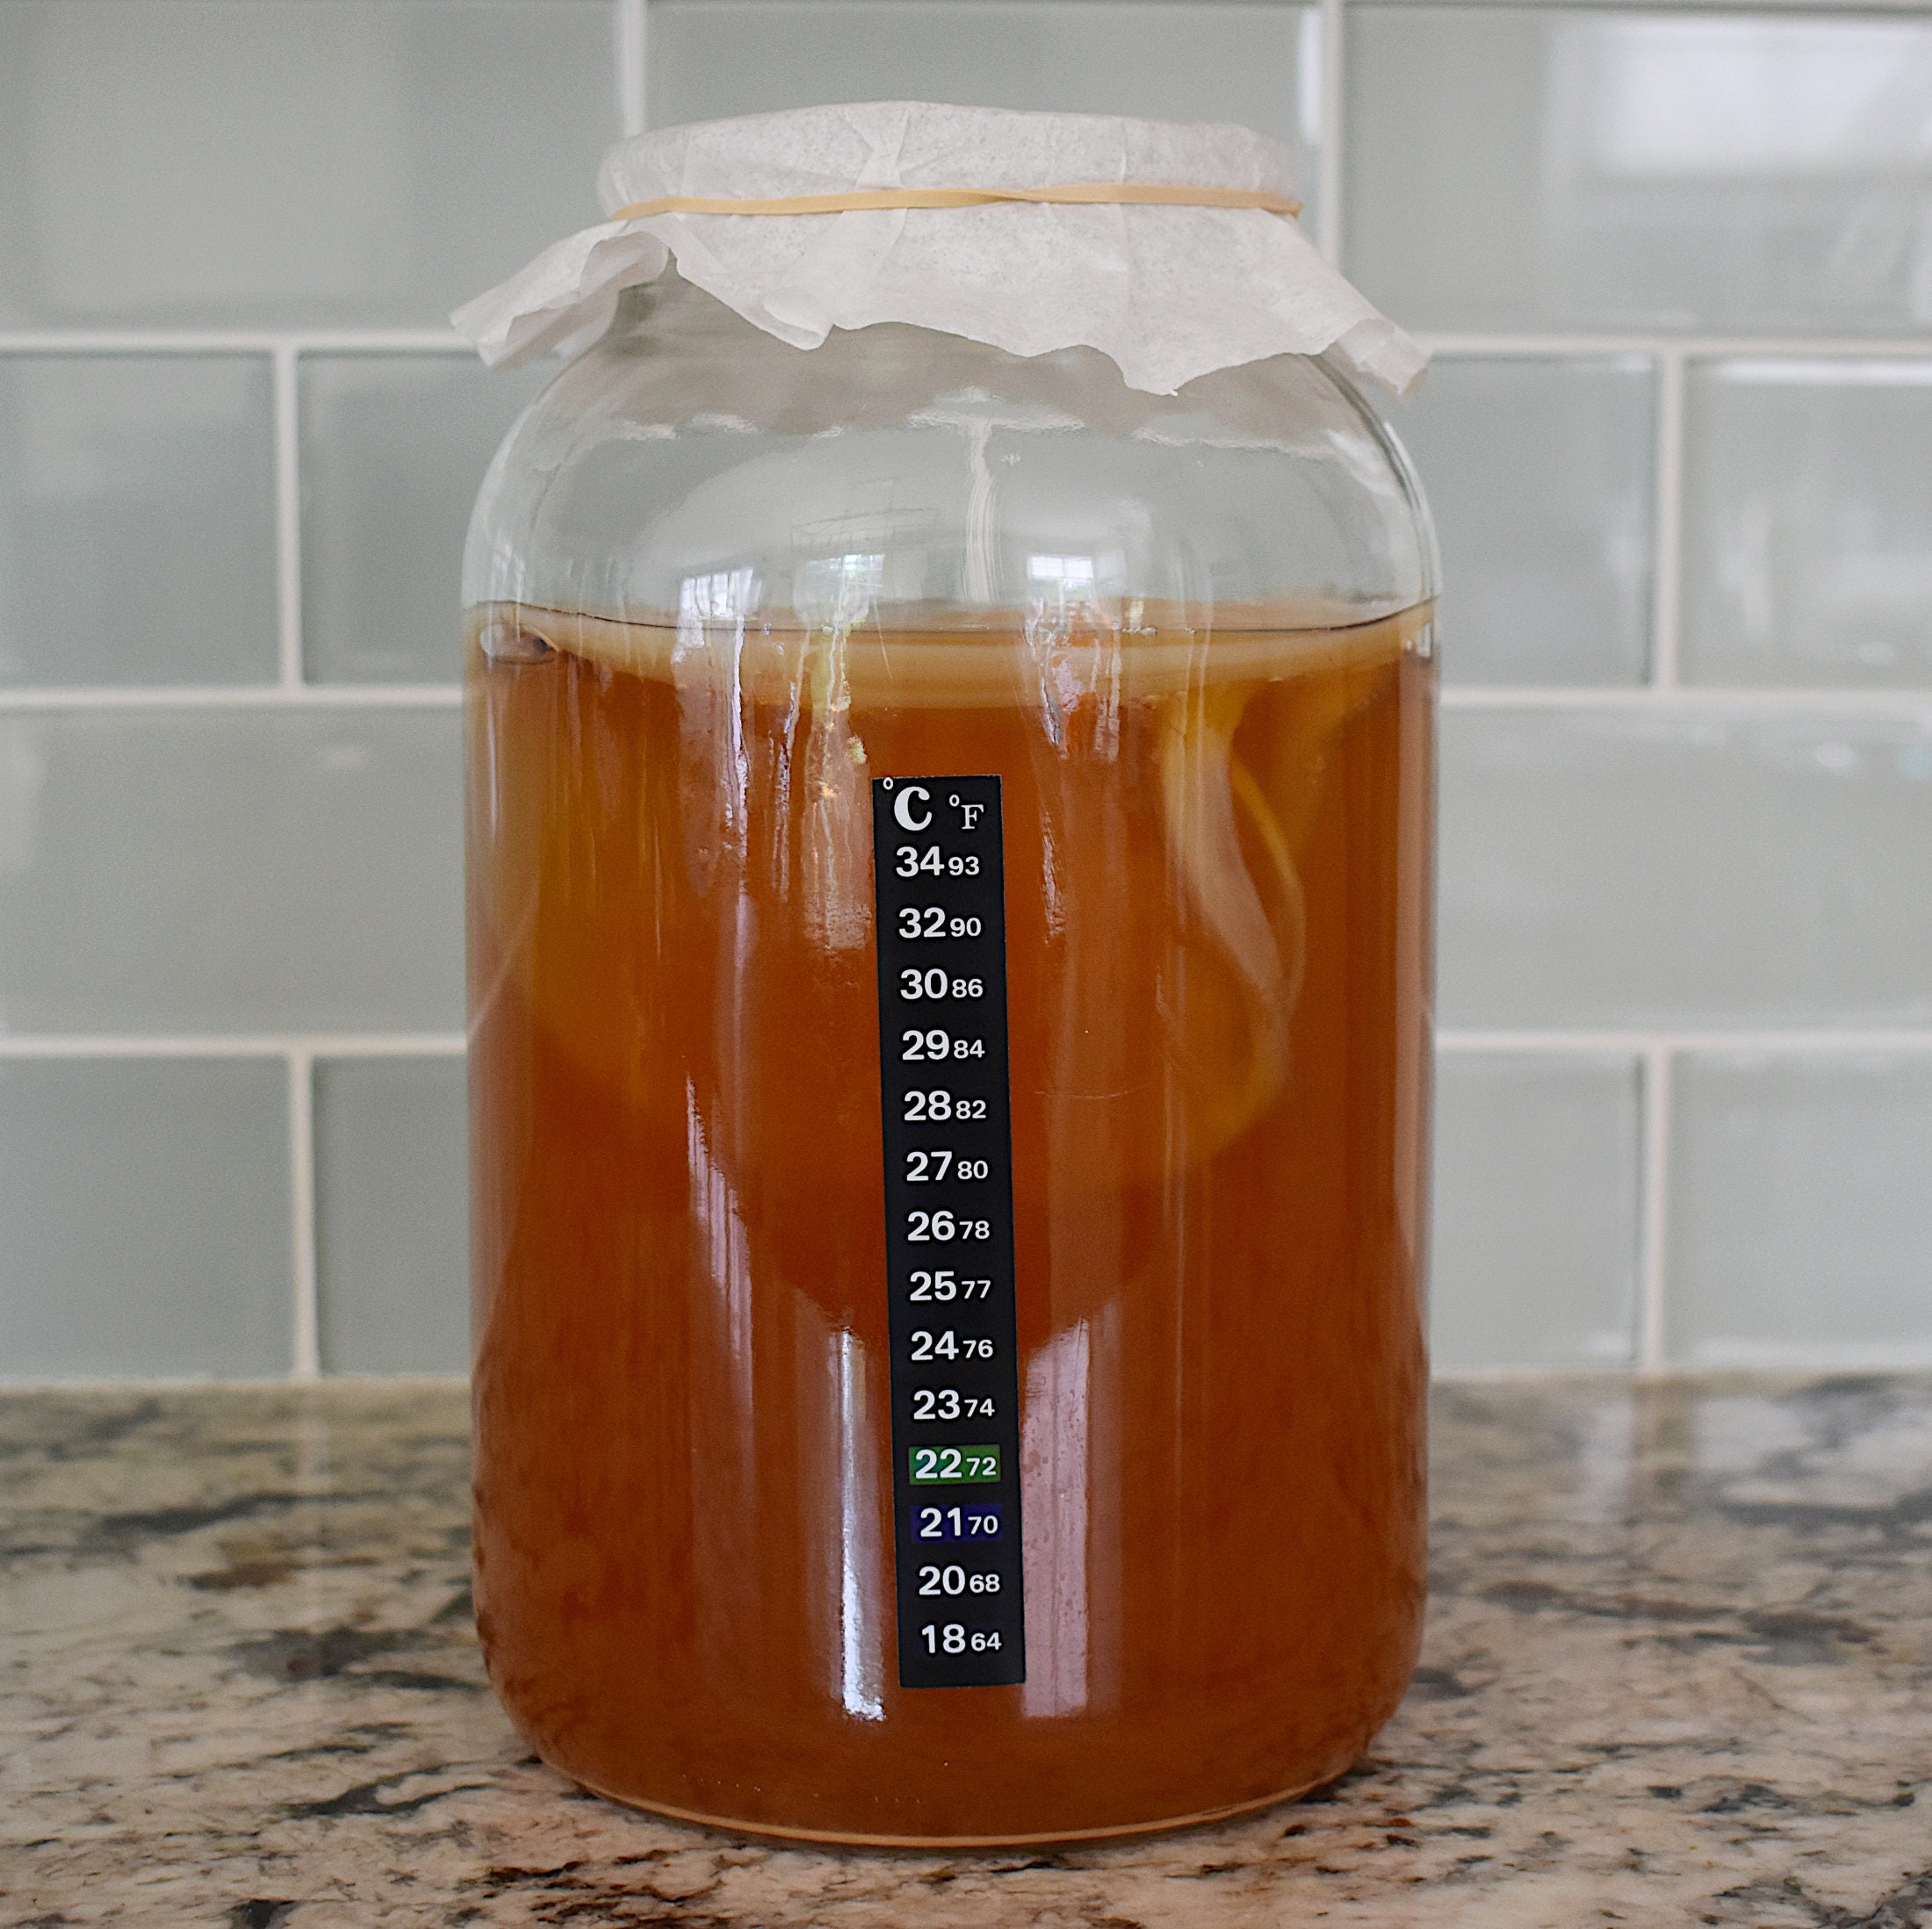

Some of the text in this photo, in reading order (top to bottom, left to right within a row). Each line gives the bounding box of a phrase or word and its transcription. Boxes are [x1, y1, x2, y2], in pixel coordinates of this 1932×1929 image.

[896, 846, 980, 877] 34 93
[898, 907, 982, 939] 32 90
[900, 968, 984, 1000] 30 86
[902, 1029, 985, 1061] 29 84
[904, 1090, 986, 1121] 28 82
[906, 1150, 989, 1182] 27 80
[907, 1210, 990, 1242] 26 78
[910, 1270, 991, 1301] 25 77
[911, 1330, 993, 1361] 24 76
[913, 1389, 995, 1420] 23 74
[915, 1448, 997, 1479] 22 72
[920, 1507, 998, 1537] 21 70
[919, 1565, 1000, 1595] 20 68
[921, 1623, 1002, 1653] 18 64
